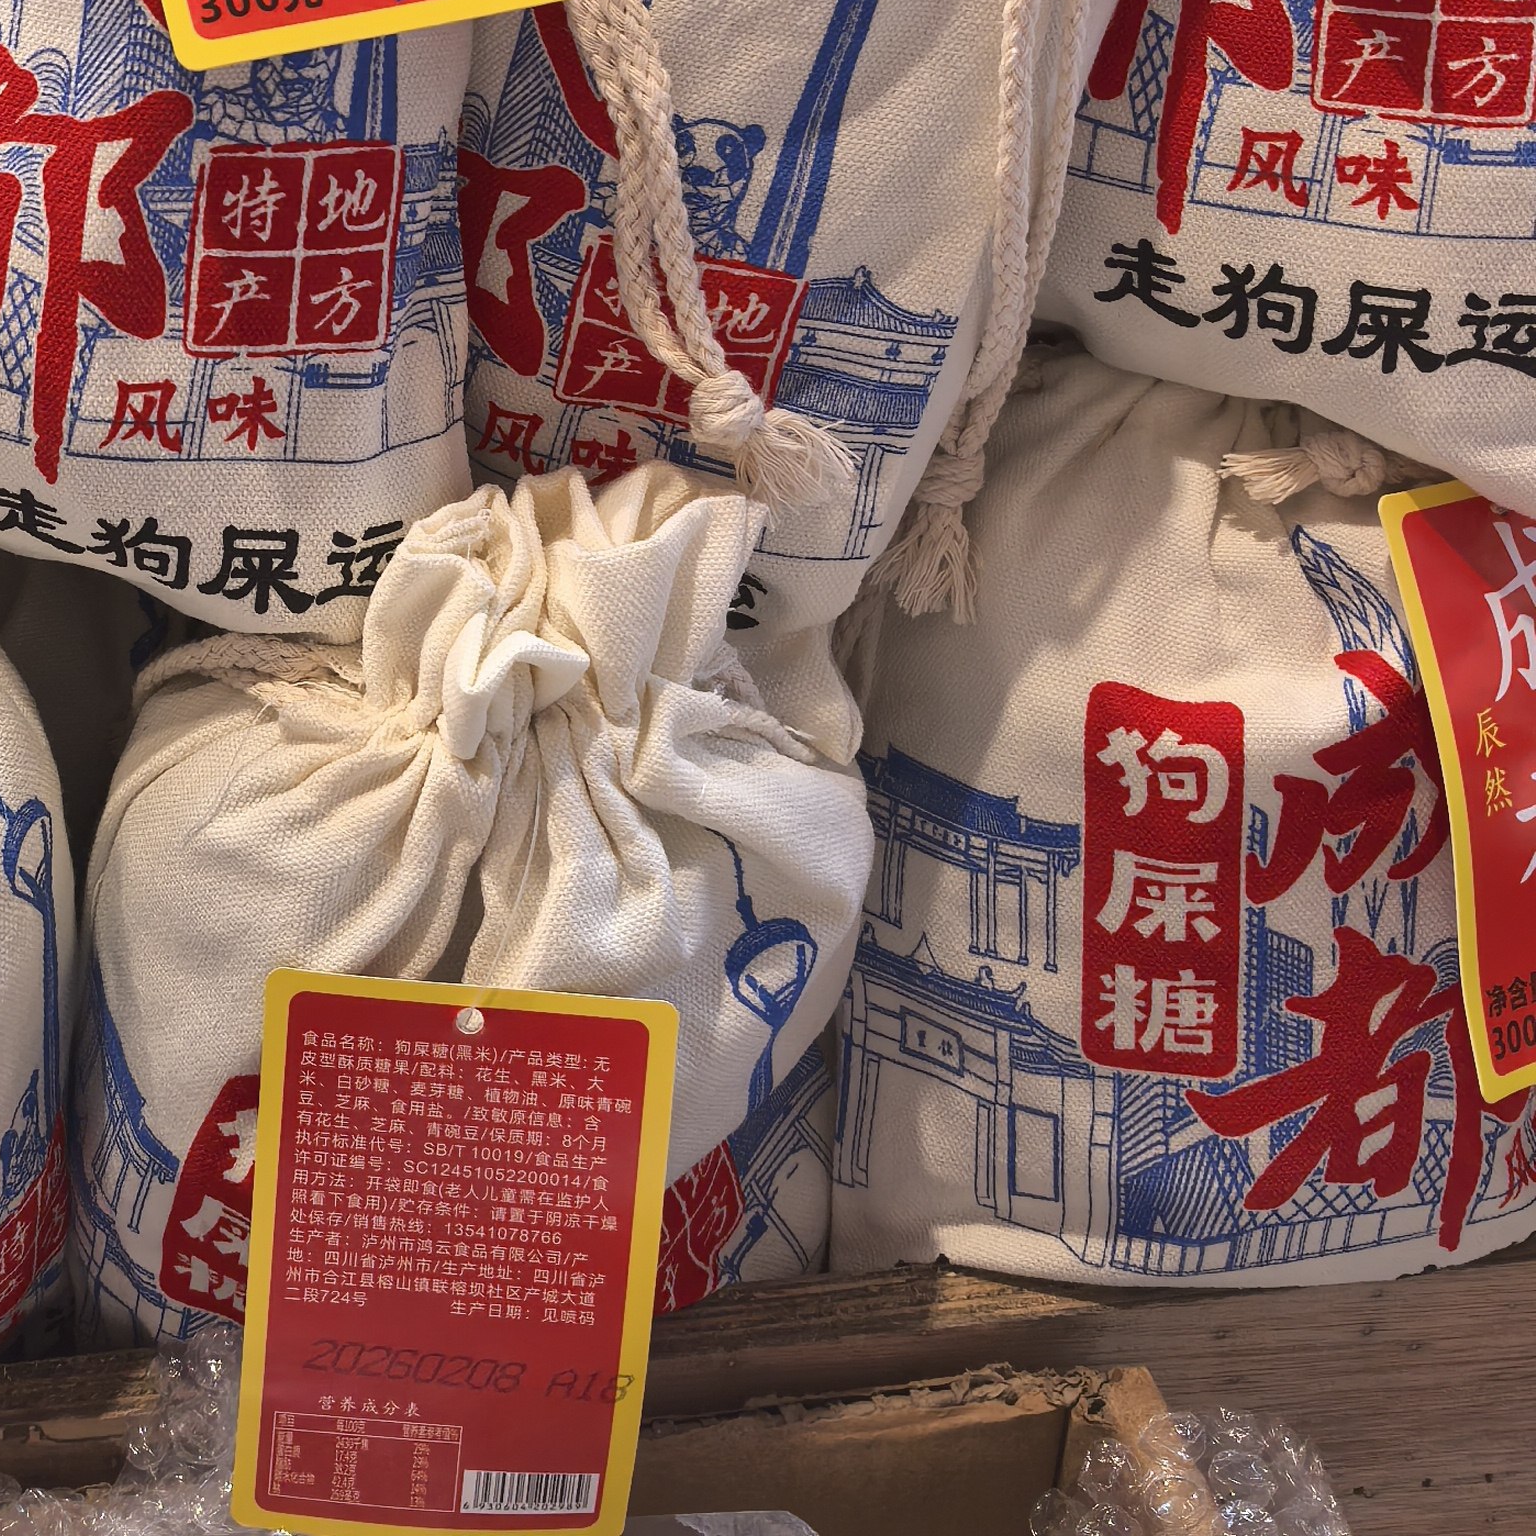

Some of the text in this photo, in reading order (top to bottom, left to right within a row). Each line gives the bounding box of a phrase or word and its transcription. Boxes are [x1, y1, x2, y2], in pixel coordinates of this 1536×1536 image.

[1226, 127, 1421, 221] 风味
[212, 173, 286, 341] 特产
[311, 169, 384, 338] 地方
[1093, 239, 1536, 374] 走狗屎运
[103, 379, 288, 453] 风味
[1474, 706, 1513, 819] 辰然
[1094, 724, 1228, 1056] 狗屎糖
[302, 1339, 528, 1394] 20260208
